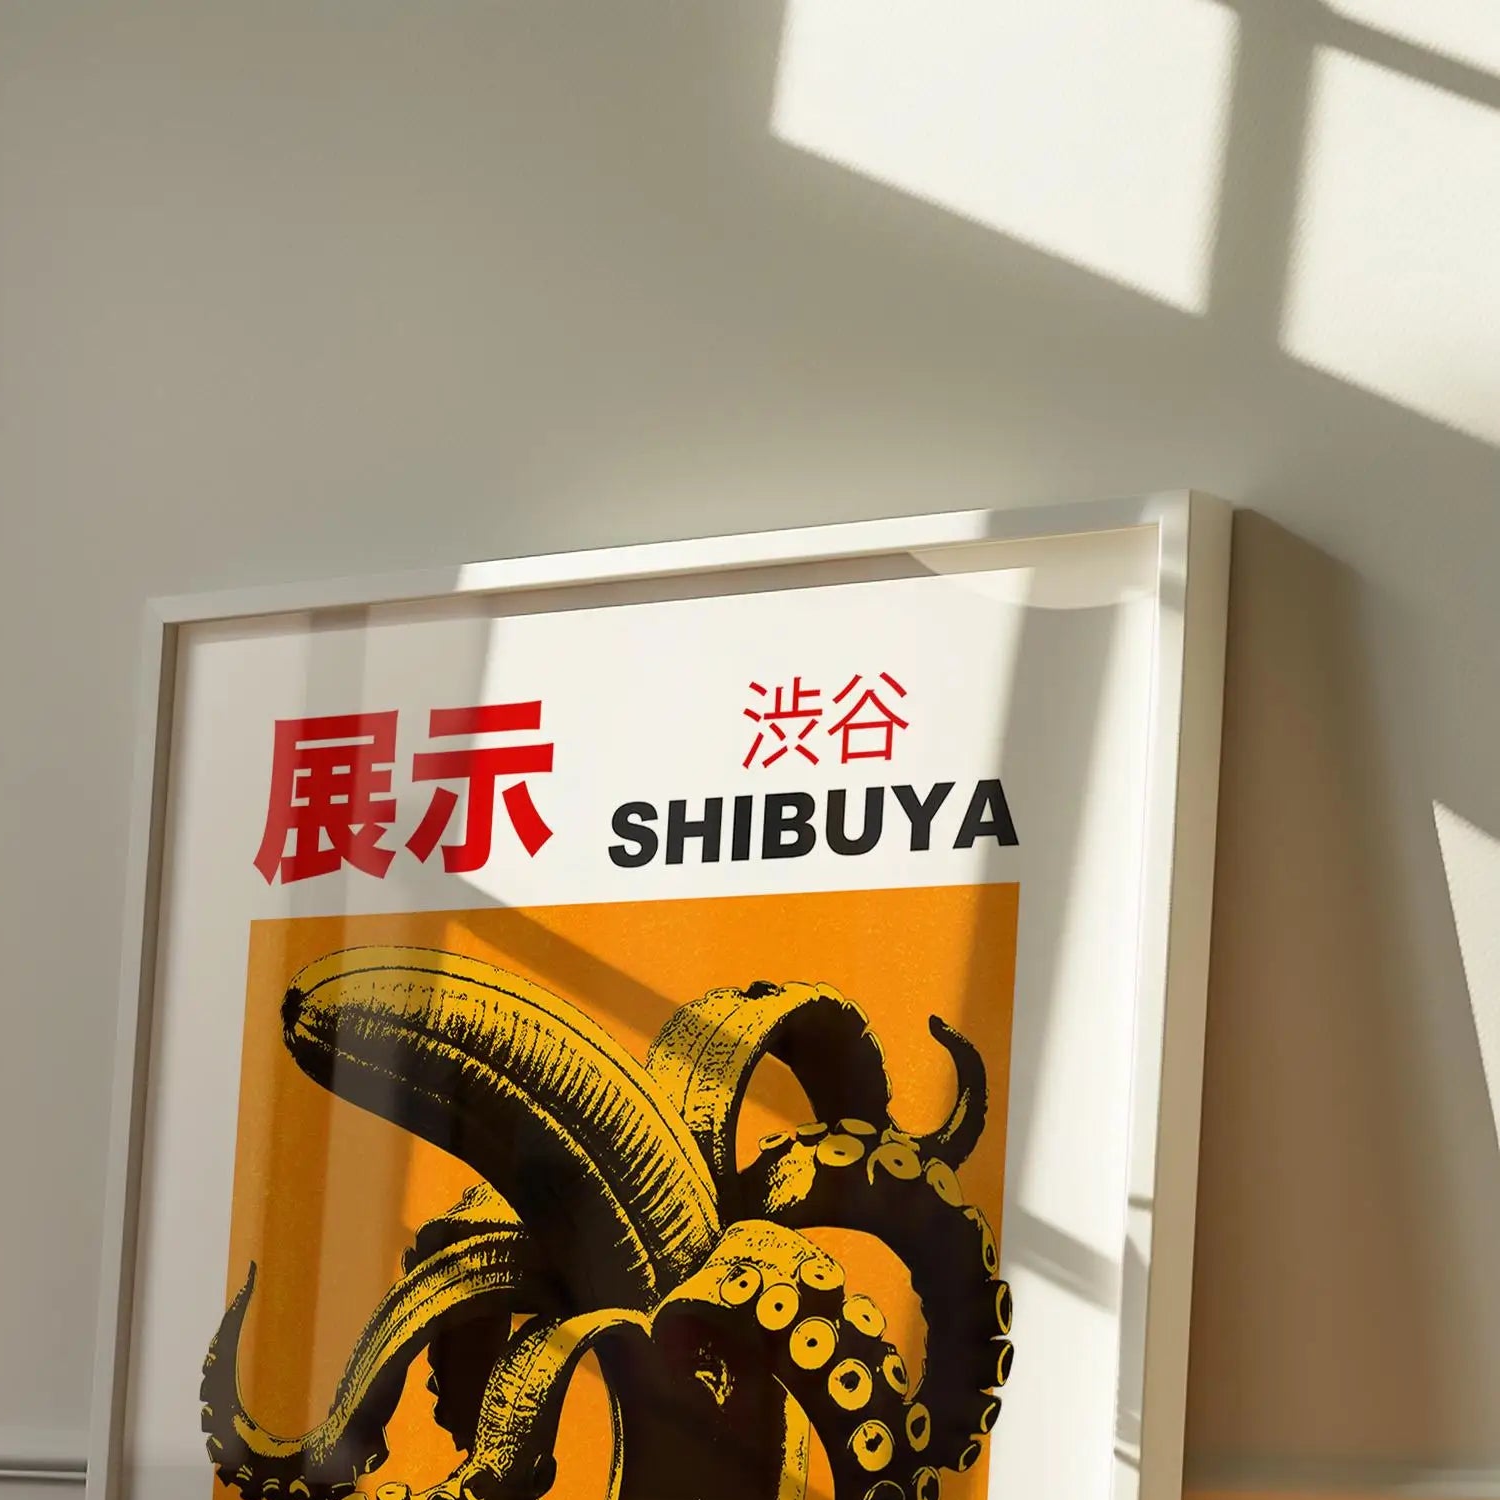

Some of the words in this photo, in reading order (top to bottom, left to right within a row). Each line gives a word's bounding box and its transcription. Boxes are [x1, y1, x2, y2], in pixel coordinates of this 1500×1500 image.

[742, 671, 910, 769] 渋谷
[254, 698, 555, 886] 展示
[608, 778, 1020, 868] SHIBUYA
